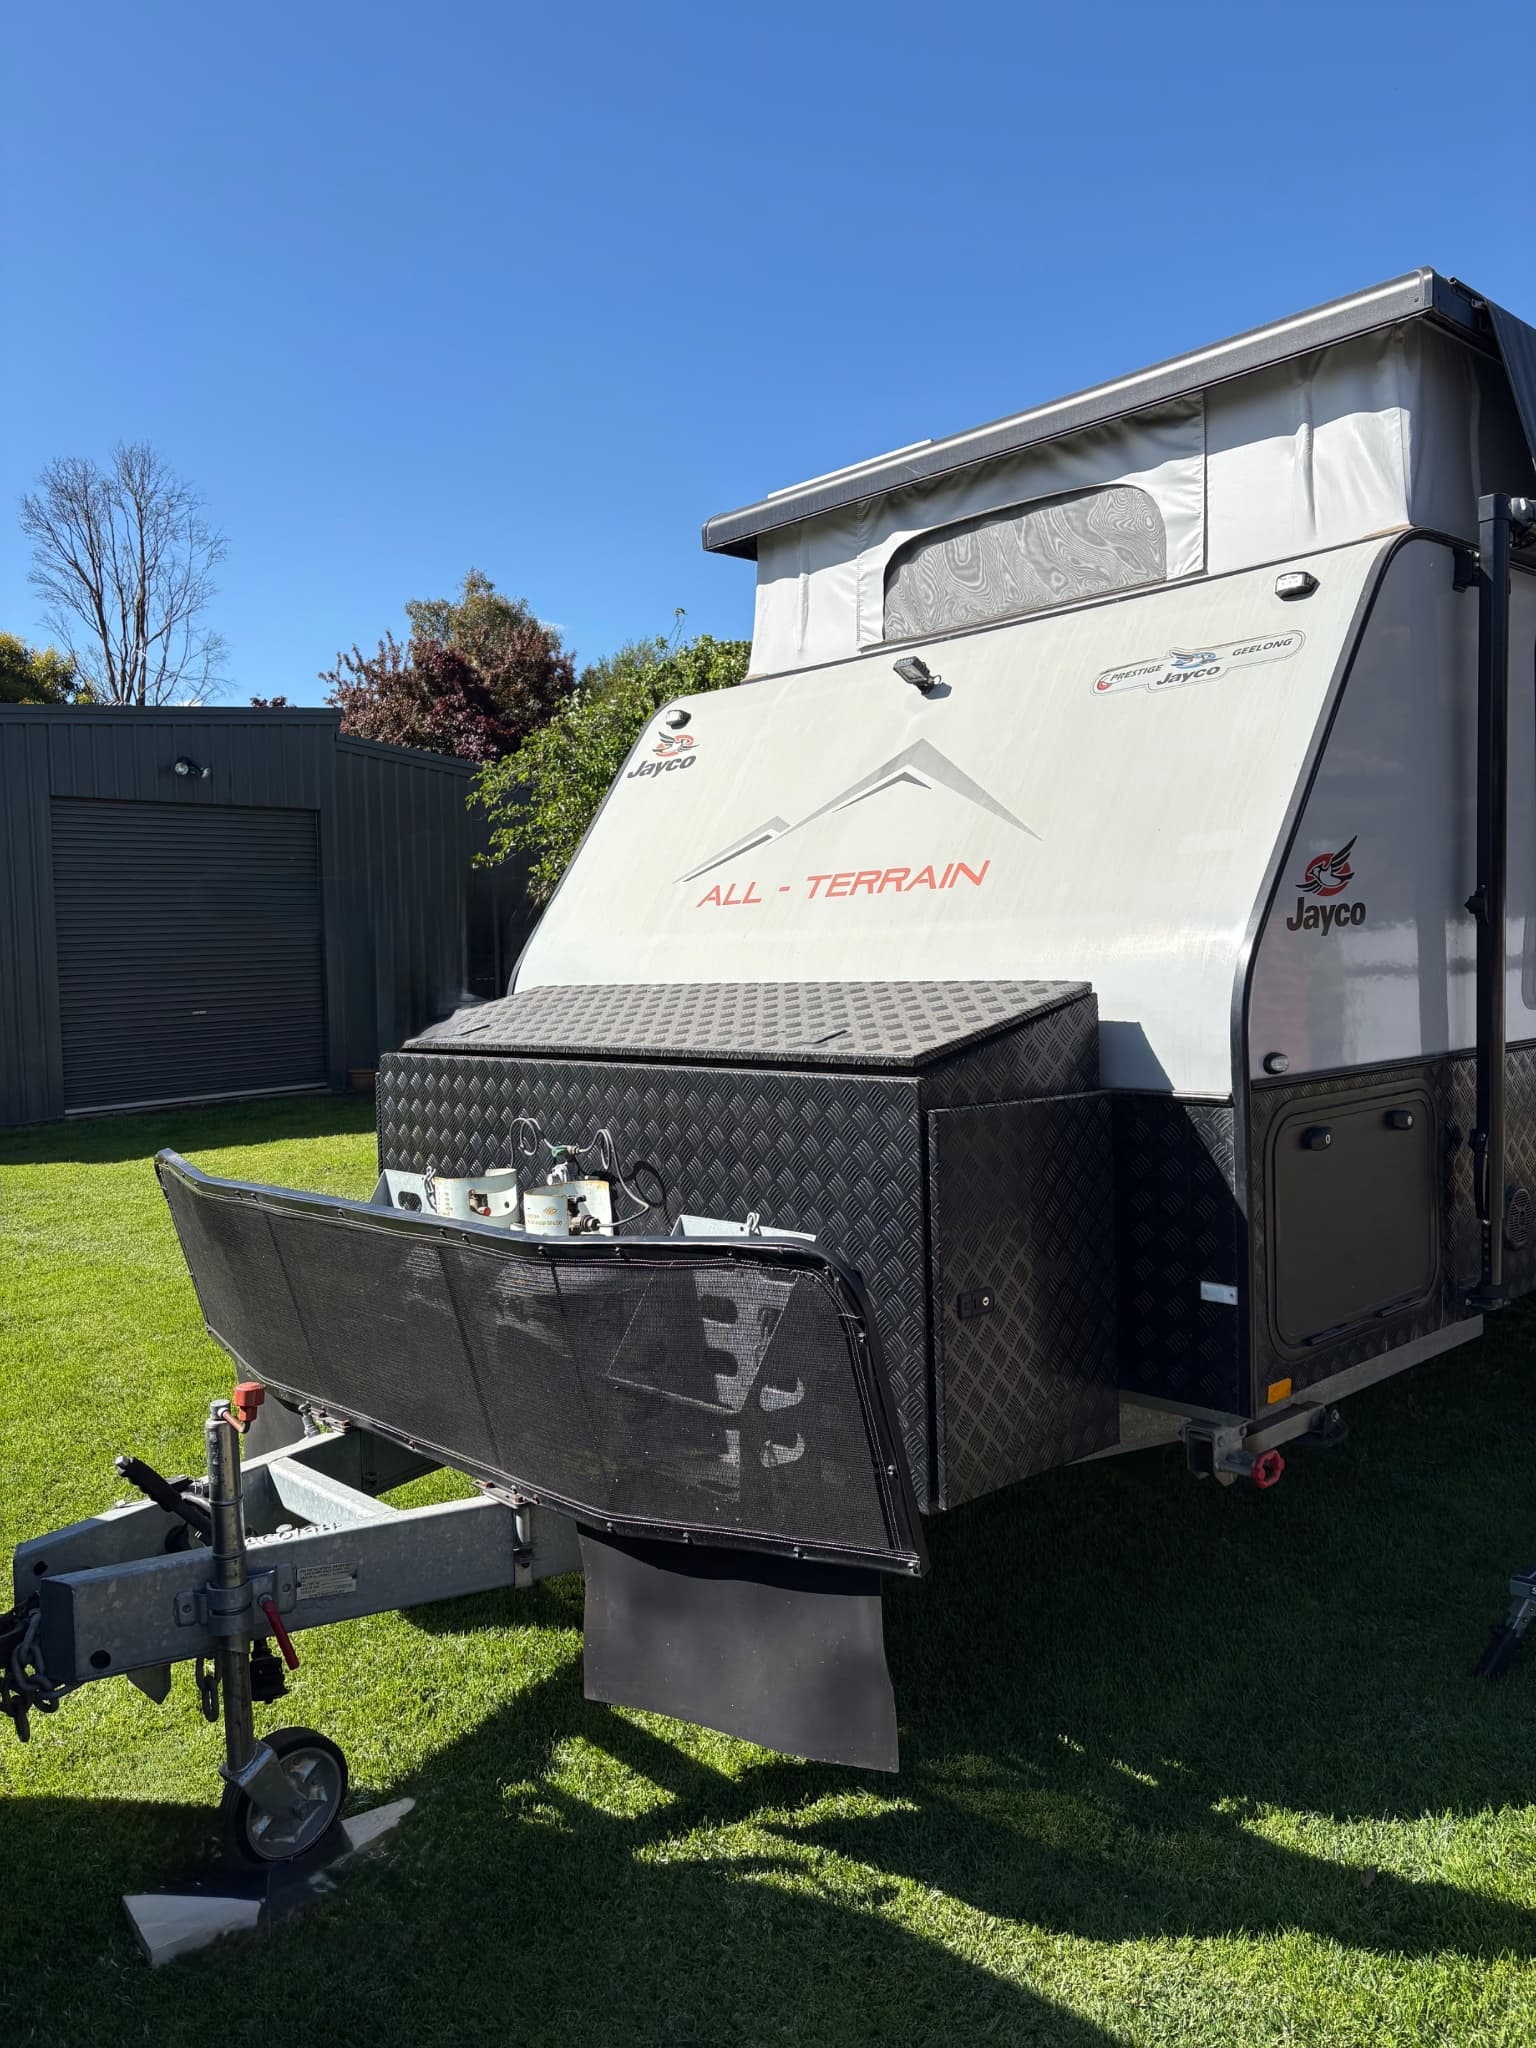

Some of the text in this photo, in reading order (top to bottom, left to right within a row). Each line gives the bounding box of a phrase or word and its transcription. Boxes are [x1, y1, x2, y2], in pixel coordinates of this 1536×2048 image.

[1110, 638, 1293, 686] PRESTIGE Jayco GEELONG
[627, 755, 697, 778] Jayco
[696, 881, 762, 908] ALL
[807, 860, 991, 899] TERRAIN
[1286, 897, 1367, 937] Jayco
